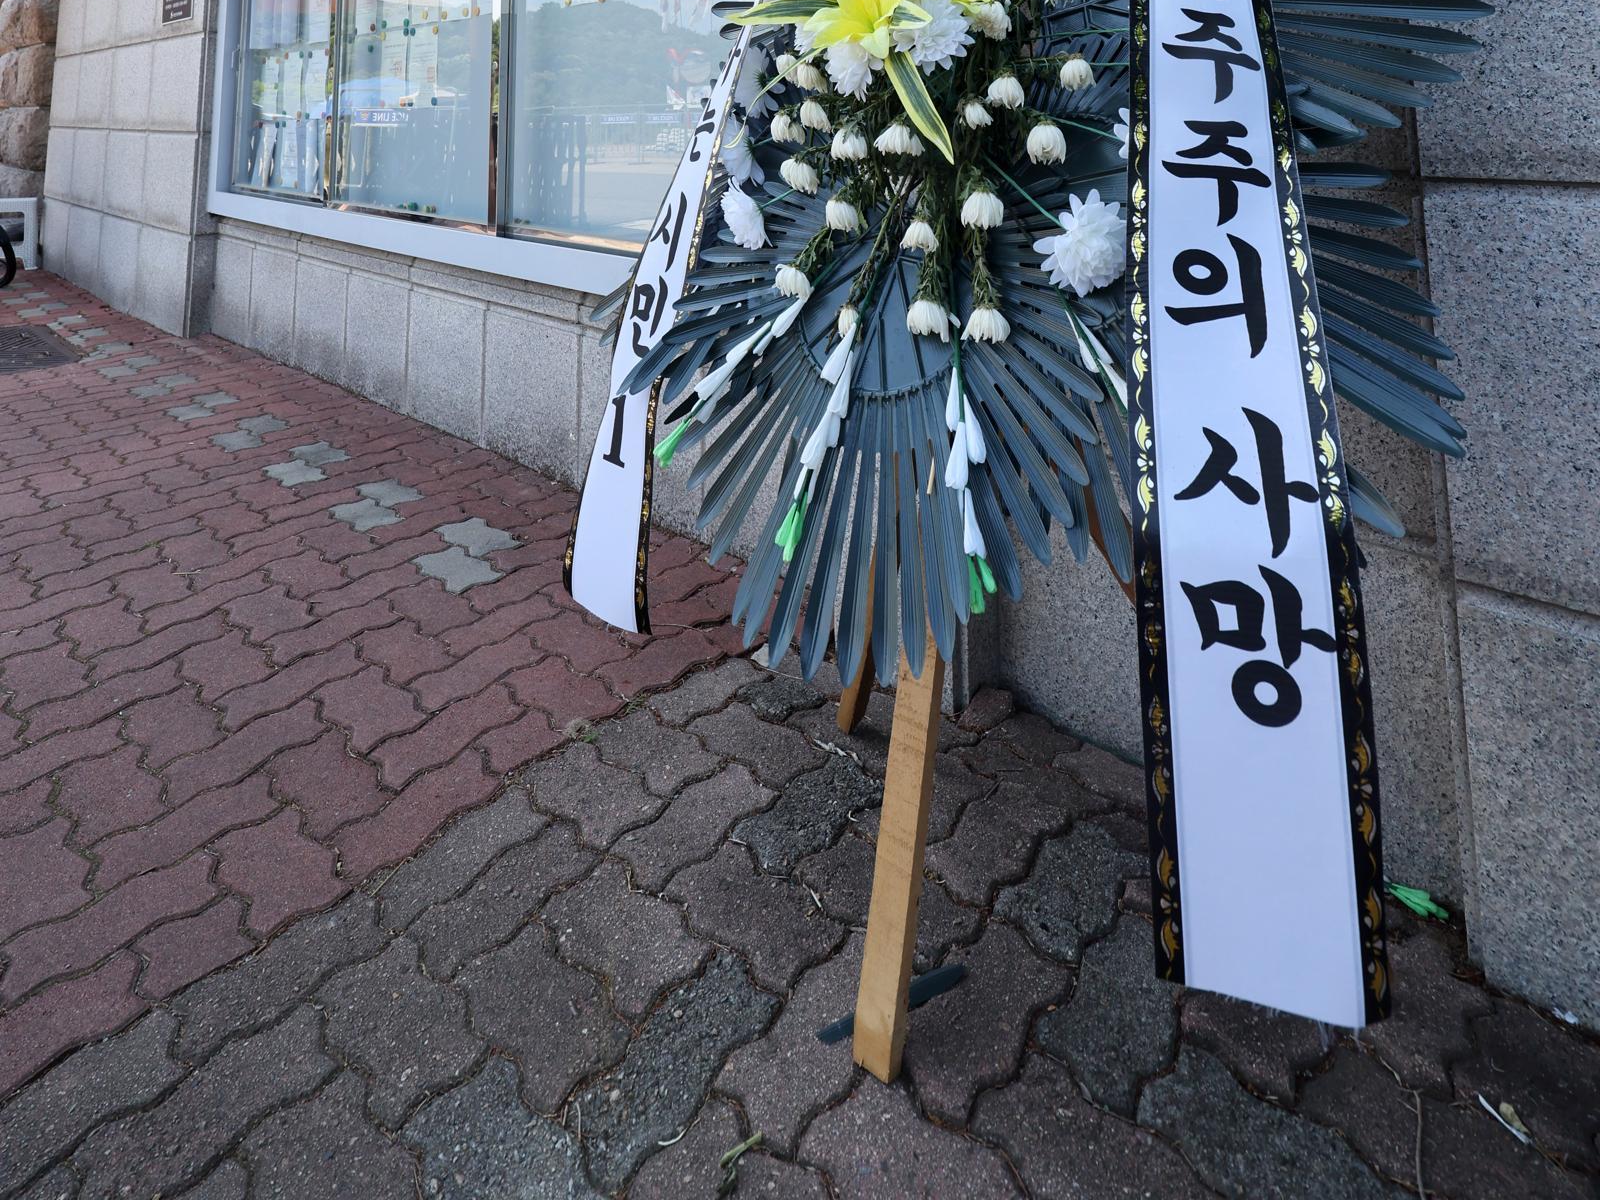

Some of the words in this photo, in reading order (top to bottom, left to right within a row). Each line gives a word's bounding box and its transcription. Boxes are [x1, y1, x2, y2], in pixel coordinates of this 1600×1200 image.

[630, 191, 688, 359] 시민
[602, 394, 627, 469] 1
[1173, 406, 1336, 728] 사망
